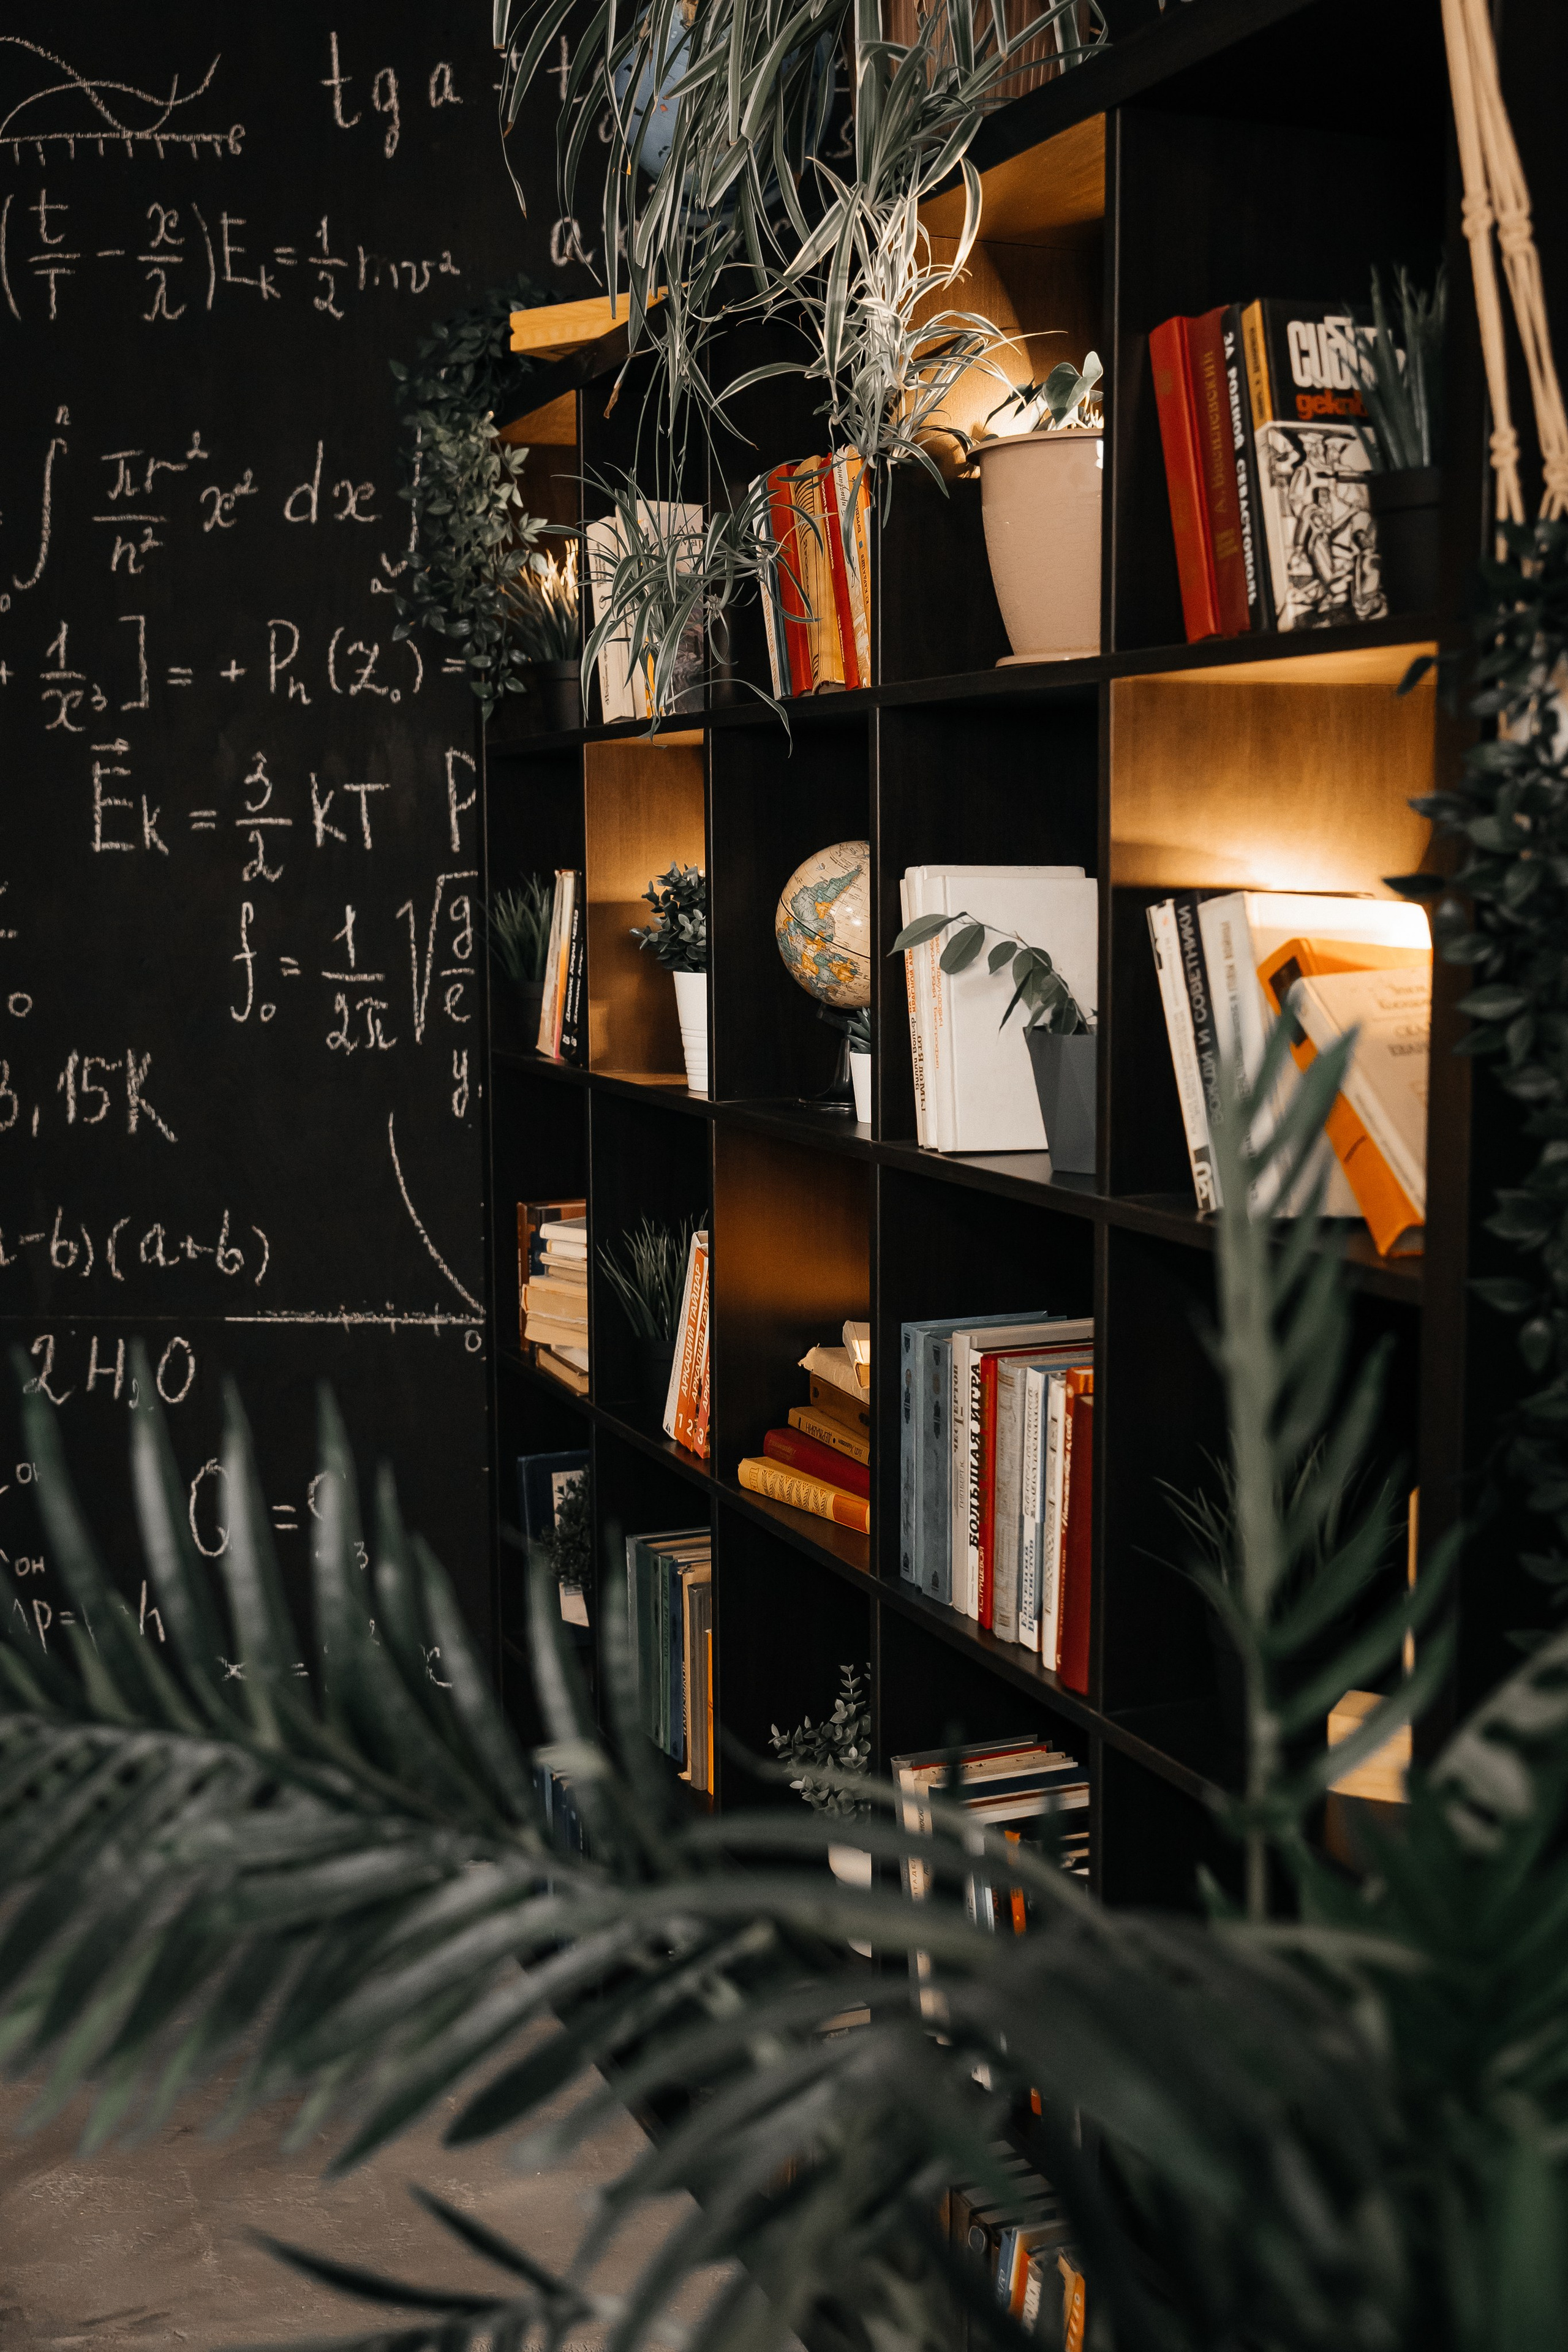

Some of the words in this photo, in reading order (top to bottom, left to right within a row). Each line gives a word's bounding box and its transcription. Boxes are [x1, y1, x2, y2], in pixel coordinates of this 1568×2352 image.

[1224, 333, 1235, 360] ЗА
[1227, 366, 1244, 450] РОДНОЙ
[680, 1324, 696, 1397] АРКАДИЙ
[689, 1263, 702, 1322] ГАЙДАР
[691, 1330, 705, 1404] АРКАДИЙ
[970, 1362, 981, 1425] ИГРА
[678, 1414, 683, 1428] 1
[687, 1419, 693, 1436] 2
[697, 1428, 704, 1444] 3
[804, 1422, 833, 1444] ДЕРЖАВИН
[968, 1428, 981, 1550] БОЛЬШАЯ
